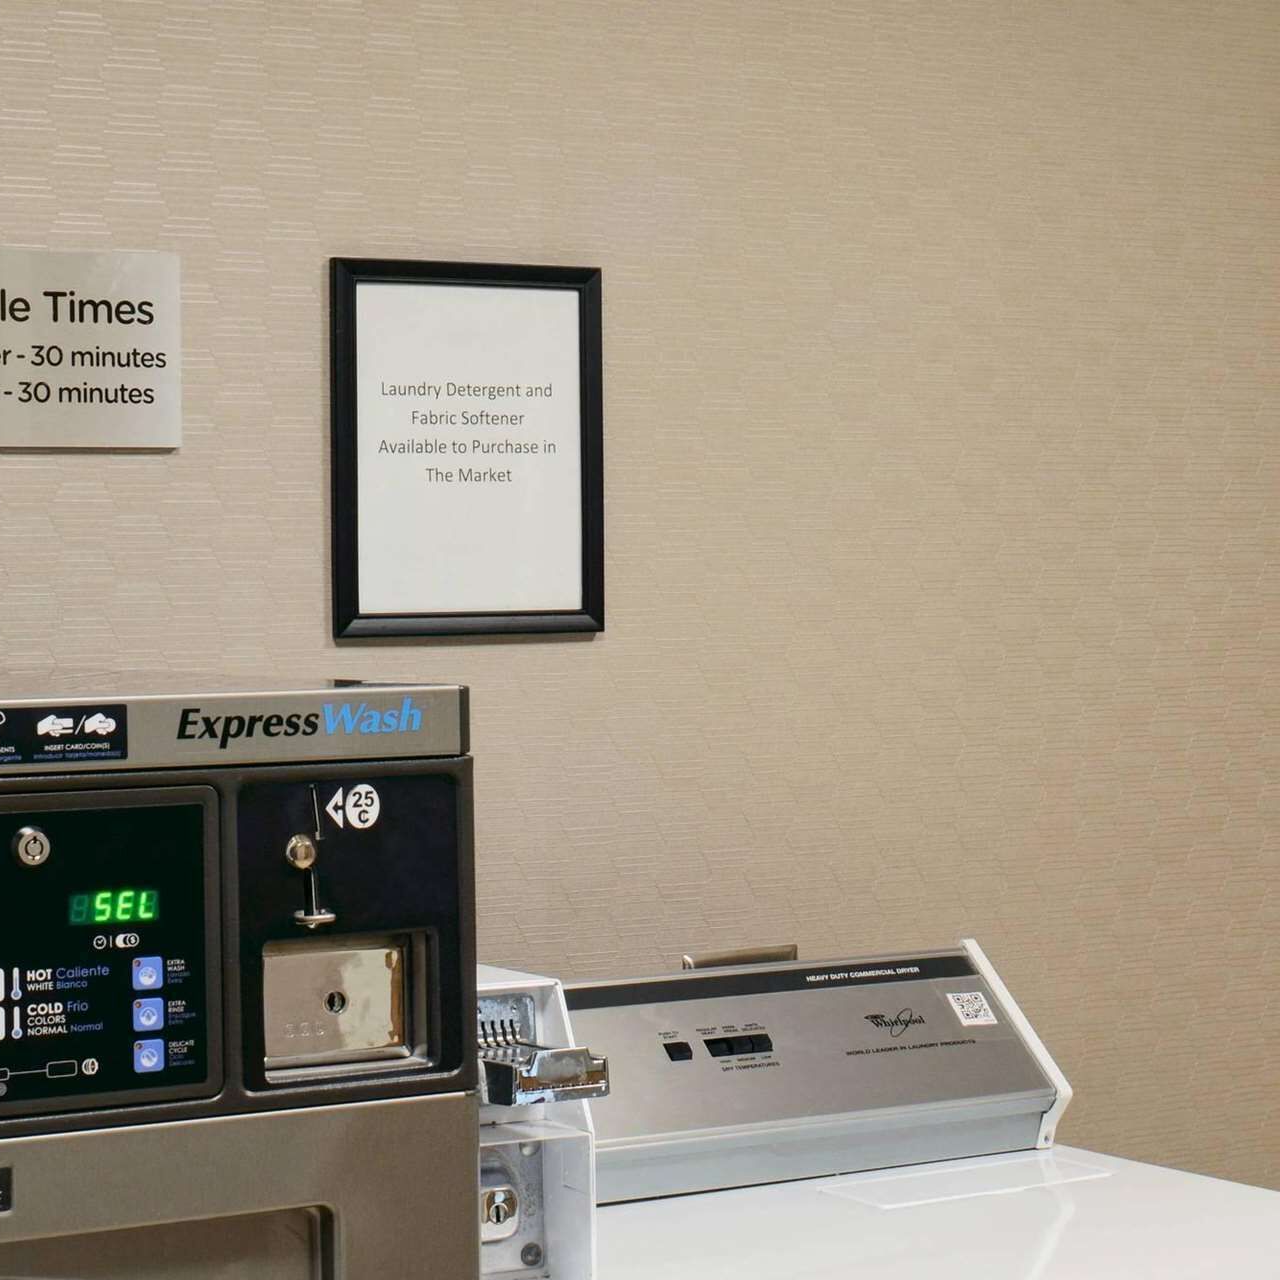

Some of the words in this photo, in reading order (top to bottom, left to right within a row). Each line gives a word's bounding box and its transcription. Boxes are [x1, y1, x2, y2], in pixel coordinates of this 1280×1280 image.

[43, 291, 154, 325] Times
[31, 345, 63, 367] 30
[71, 346, 167, 368] minutes
[18, 382, 51, 404] 30
[58, 383, 154, 405] minutes
[381, 381, 440, 401] Laundry
[447, 381, 521, 401] Detergent
[526, 382, 553, 398] and
[411, 410, 456, 425] Fabric
[461, 409, 525, 426] Softener
[378, 438, 446, 455] Available
[452, 440, 467, 455] to
[472, 437, 538, 455] Purchase
[543, 438, 557, 455] in
[426, 466, 453, 483] The
[458, 466, 513, 483] Market
[352, 791, 374, 808] 25
[94, 890, 155, 922] SEL
[26, 968, 53, 982] HOT
[56, 965, 109, 980] Caliente
[805, 974, 829, 983] HEAVY
[829, 972, 848, 981] DUTY
[849, 968, 896, 979] COMMERCIAL
[896, 966, 920, 975] DRYER
[26, 982, 54, 991] WHITE
[27, 1002, 63, 1016] COLD
[27, 1015, 66, 1026] COLORS
[27, 1025, 68, 1037] NORMAL
